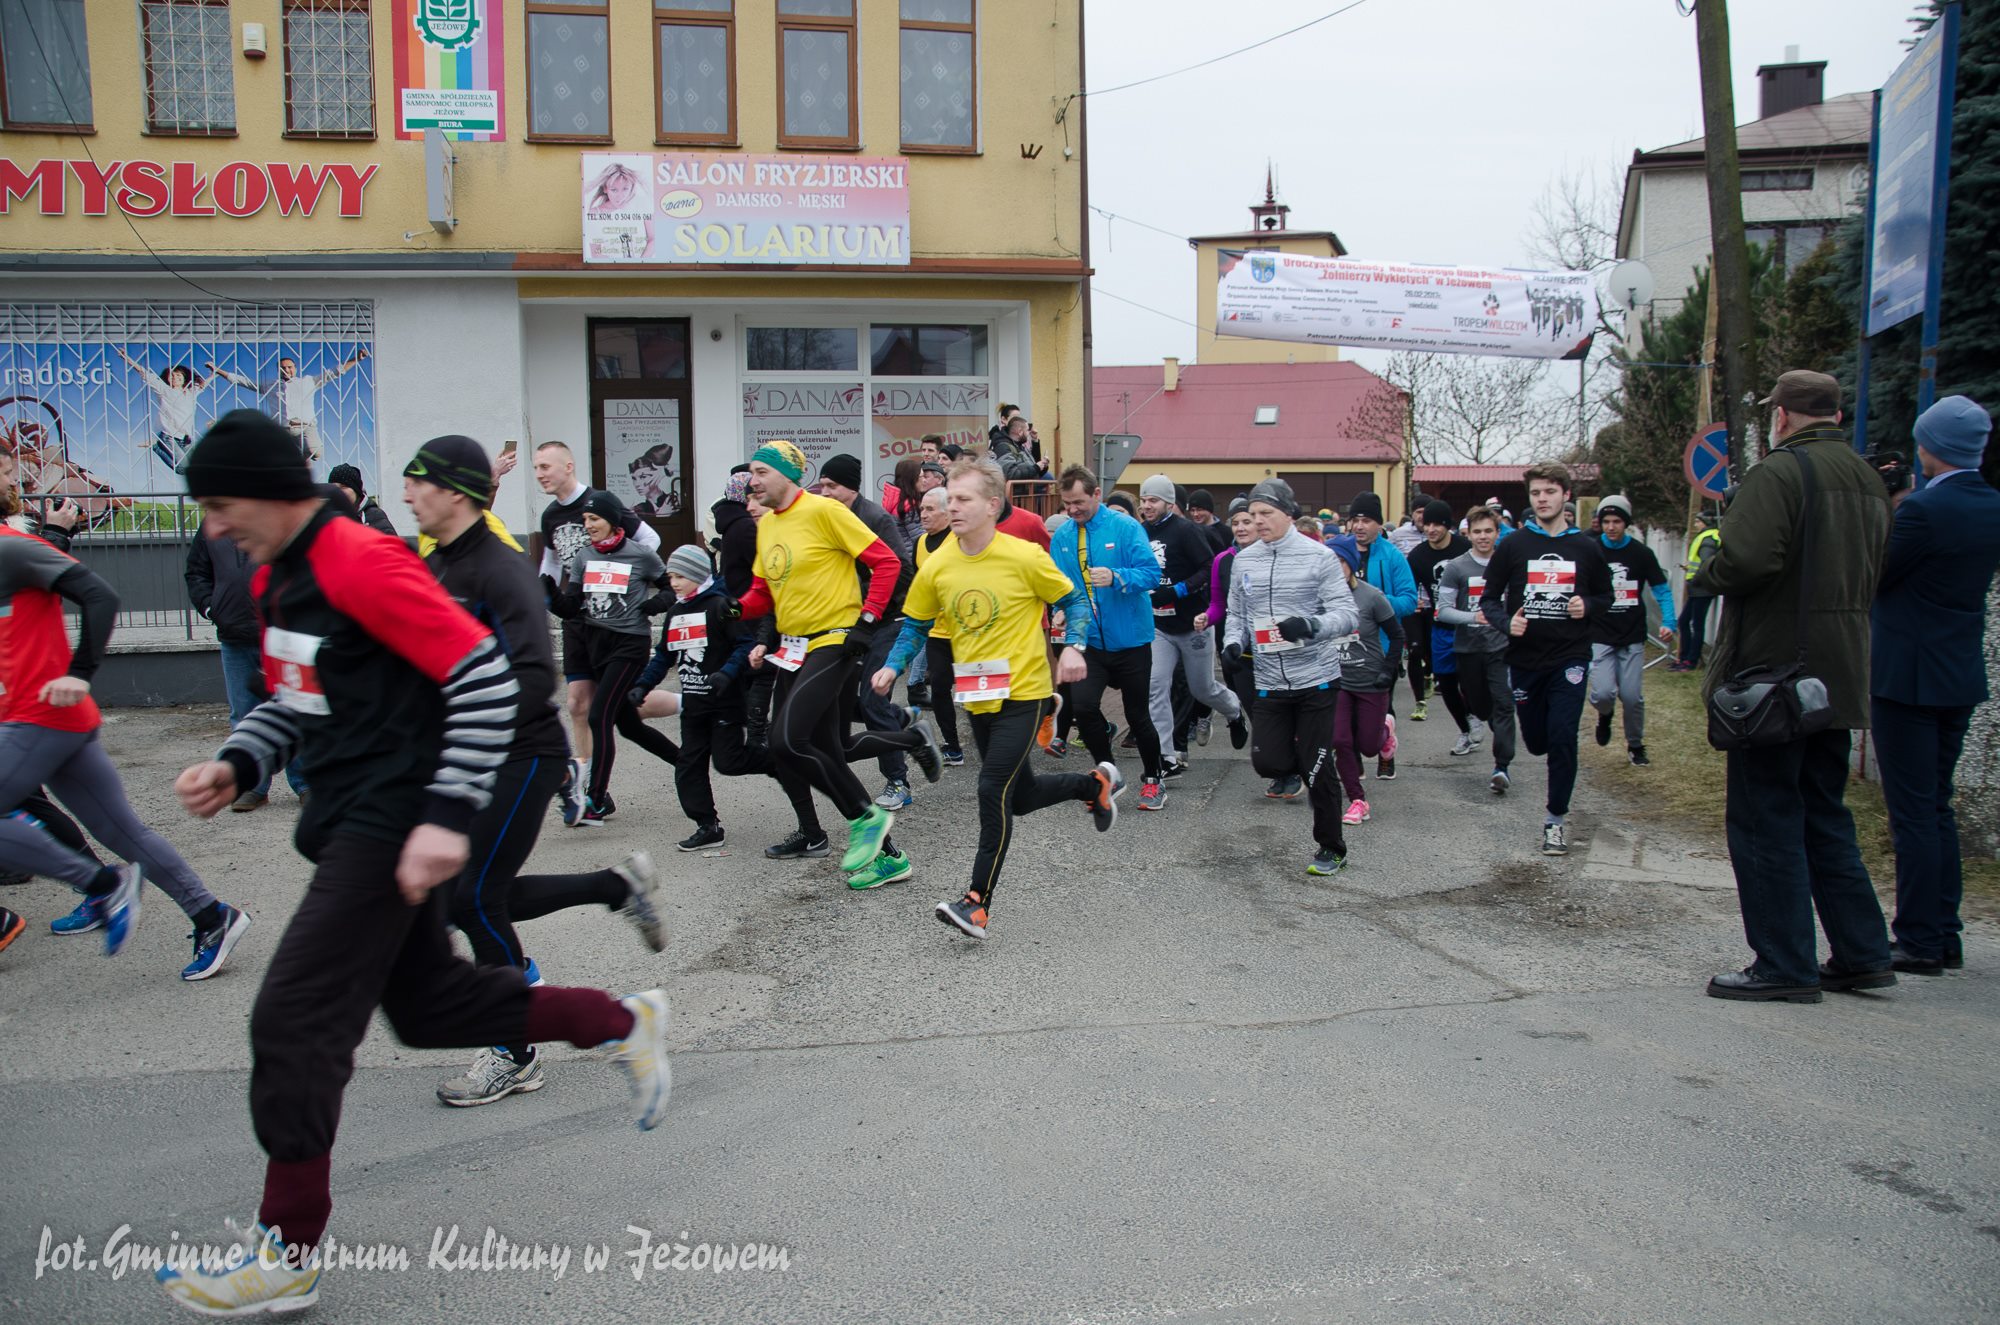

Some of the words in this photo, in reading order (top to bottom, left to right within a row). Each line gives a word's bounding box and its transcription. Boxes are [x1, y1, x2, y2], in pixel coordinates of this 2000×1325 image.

[431, 22, 466, 31] JEŻOWE
[440, 92, 492, 100] SPÓŁDZIELNIA
[657, 161, 745, 186] SALON
[753, 163, 905, 189] FRYZJERSKI
[715, 192, 782, 208] DAMSKO
[798, 194, 846, 210] MĘSKI
[673, 223, 902, 259] SOLARIUM
[4, 361, 112, 385] radości
[767, 389, 846, 412] DANA
[890, 389, 971, 411] DANA
[616, 402, 666, 416] DANA
[757, 428, 795, 437] strzyżenie
[797, 427, 828, 435] damskie
[834, 427, 861, 436] męskie
[599, 573, 613, 584] 70
[1543, 572, 1559, 584] 72
[678, 627, 690, 640] 71
[978, 676, 988, 690] 6
